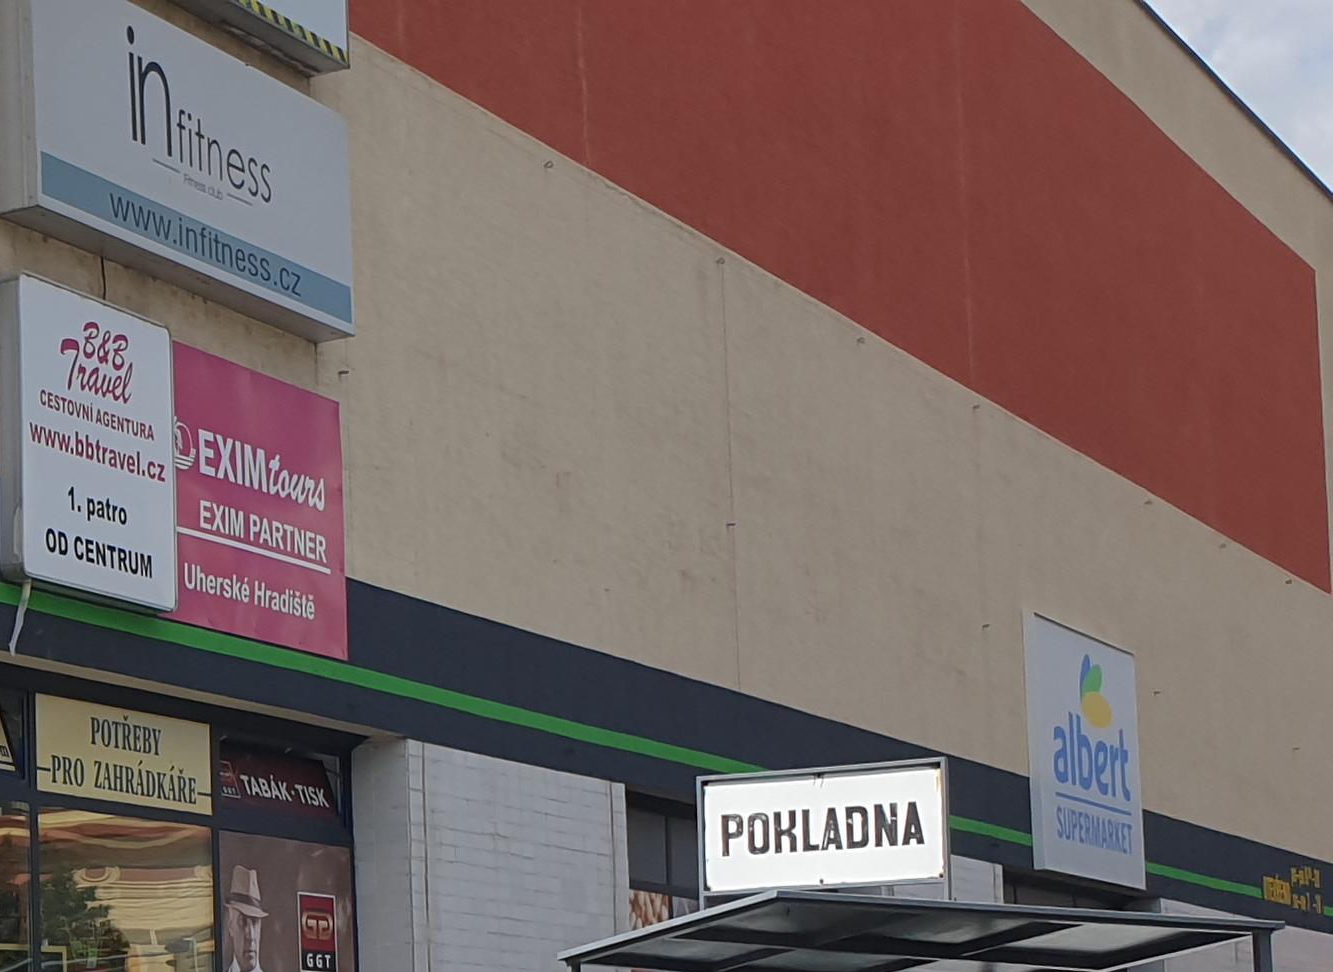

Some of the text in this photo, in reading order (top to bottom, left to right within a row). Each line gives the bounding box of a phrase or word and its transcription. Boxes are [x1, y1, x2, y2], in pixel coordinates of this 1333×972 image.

[109, 192, 302, 297] www.infitness.cz
[60, 338, 133, 404] Travel
[83, 322, 129, 371] B&B
[39, 389, 155, 441] CESTOVNÍ AGENTURA
[29, 422, 165, 482] www.bbtravel.cz
[68, 486, 128, 525] 1. patro
[199, 500, 327, 563] EXIM PARTNER
[45, 528, 152, 578] OD CENTRUM
[184, 562, 315, 620] Uherské Hradiště
[90, 715, 162, 756] POTŘEBY
[1053, 711, 1131, 802] albert
[721, 801, 925, 857] POKLADNA
[1056, 806, 1132, 854] SUPERMARKET
[306, 953, 331, 968] GGT
